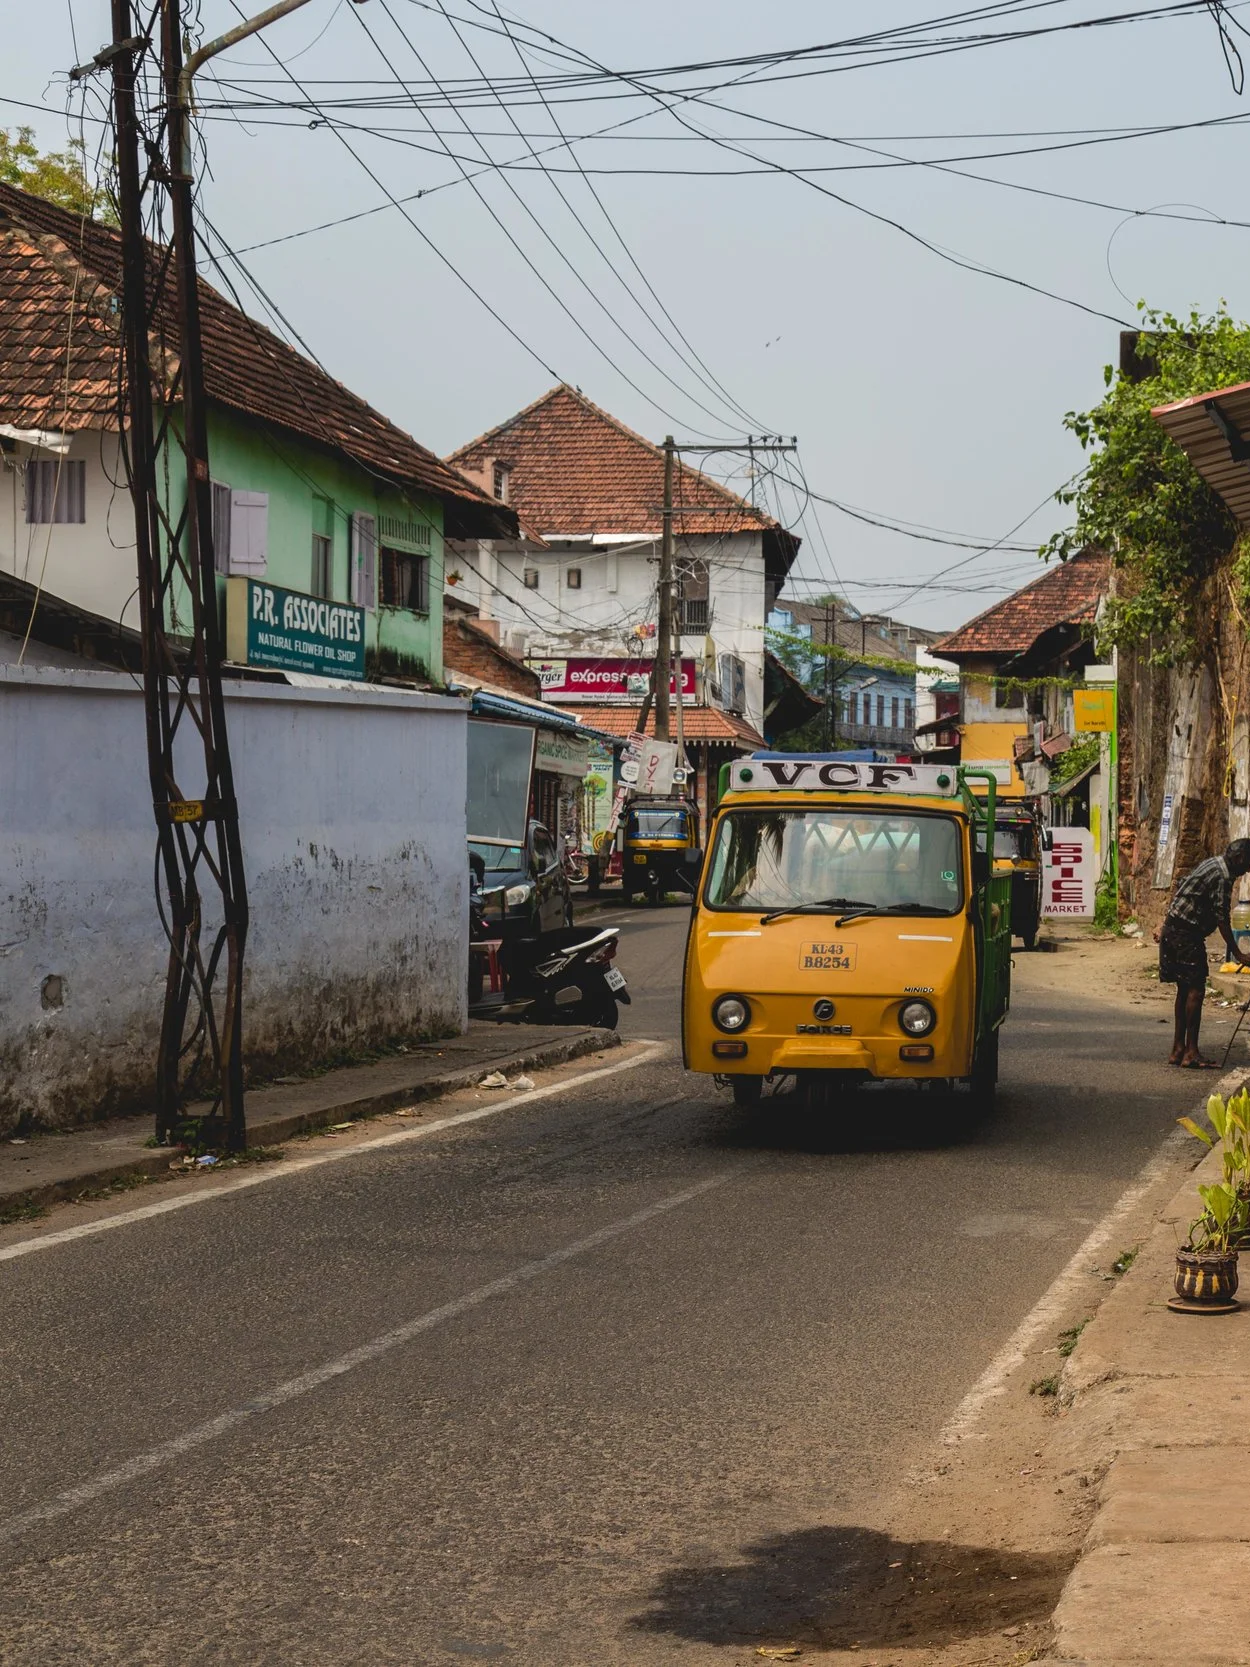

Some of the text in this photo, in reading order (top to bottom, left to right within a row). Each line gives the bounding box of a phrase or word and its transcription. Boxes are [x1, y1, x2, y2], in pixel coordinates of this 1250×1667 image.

[253, 586, 360, 642] P.R. ASSOCIATES
[258, 632, 356, 662] NATURAL FLOWER OIL SHOP
[762, 762, 917, 789] VCF
[1052, 843, 1083, 903] SPICE
[1044, 905, 1087, 913] MARKET
